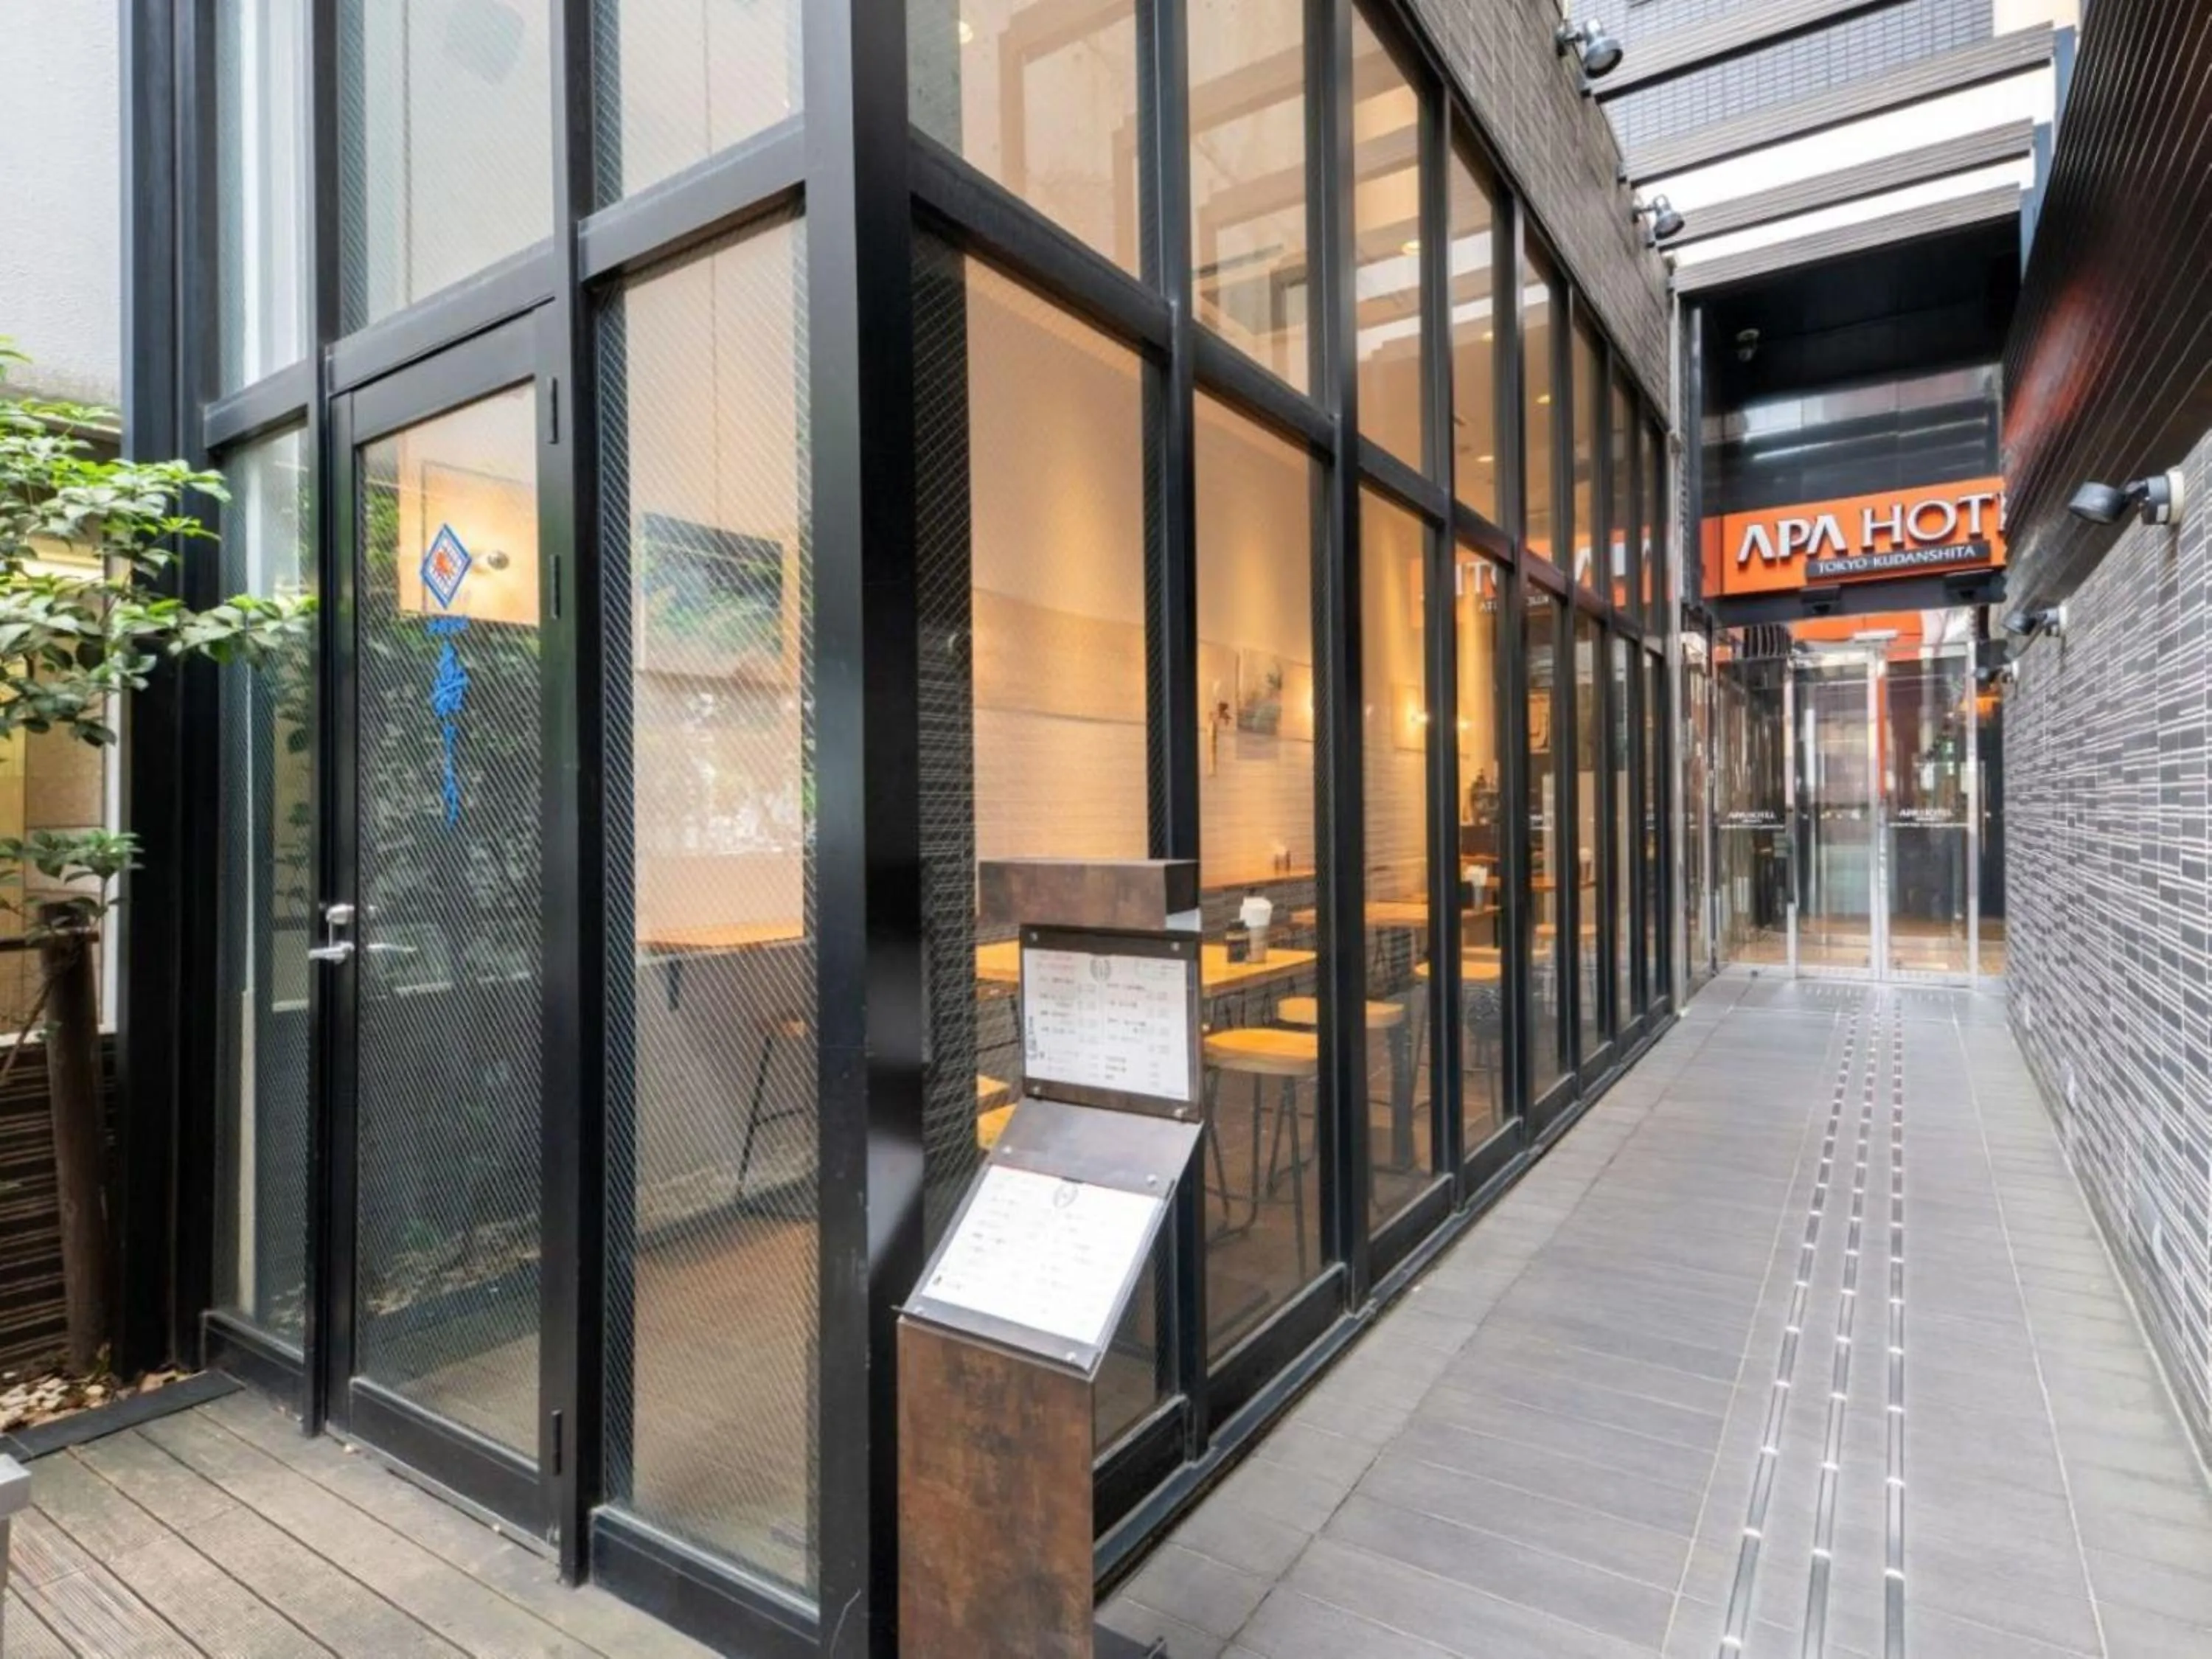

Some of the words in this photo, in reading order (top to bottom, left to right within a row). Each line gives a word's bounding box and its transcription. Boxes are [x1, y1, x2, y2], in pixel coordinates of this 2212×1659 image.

[1737, 514, 1847, 563] APA
[1818, 557, 1868, 574] TOKYO
[1873, 545, 1976, 568] KUDANSHITA
